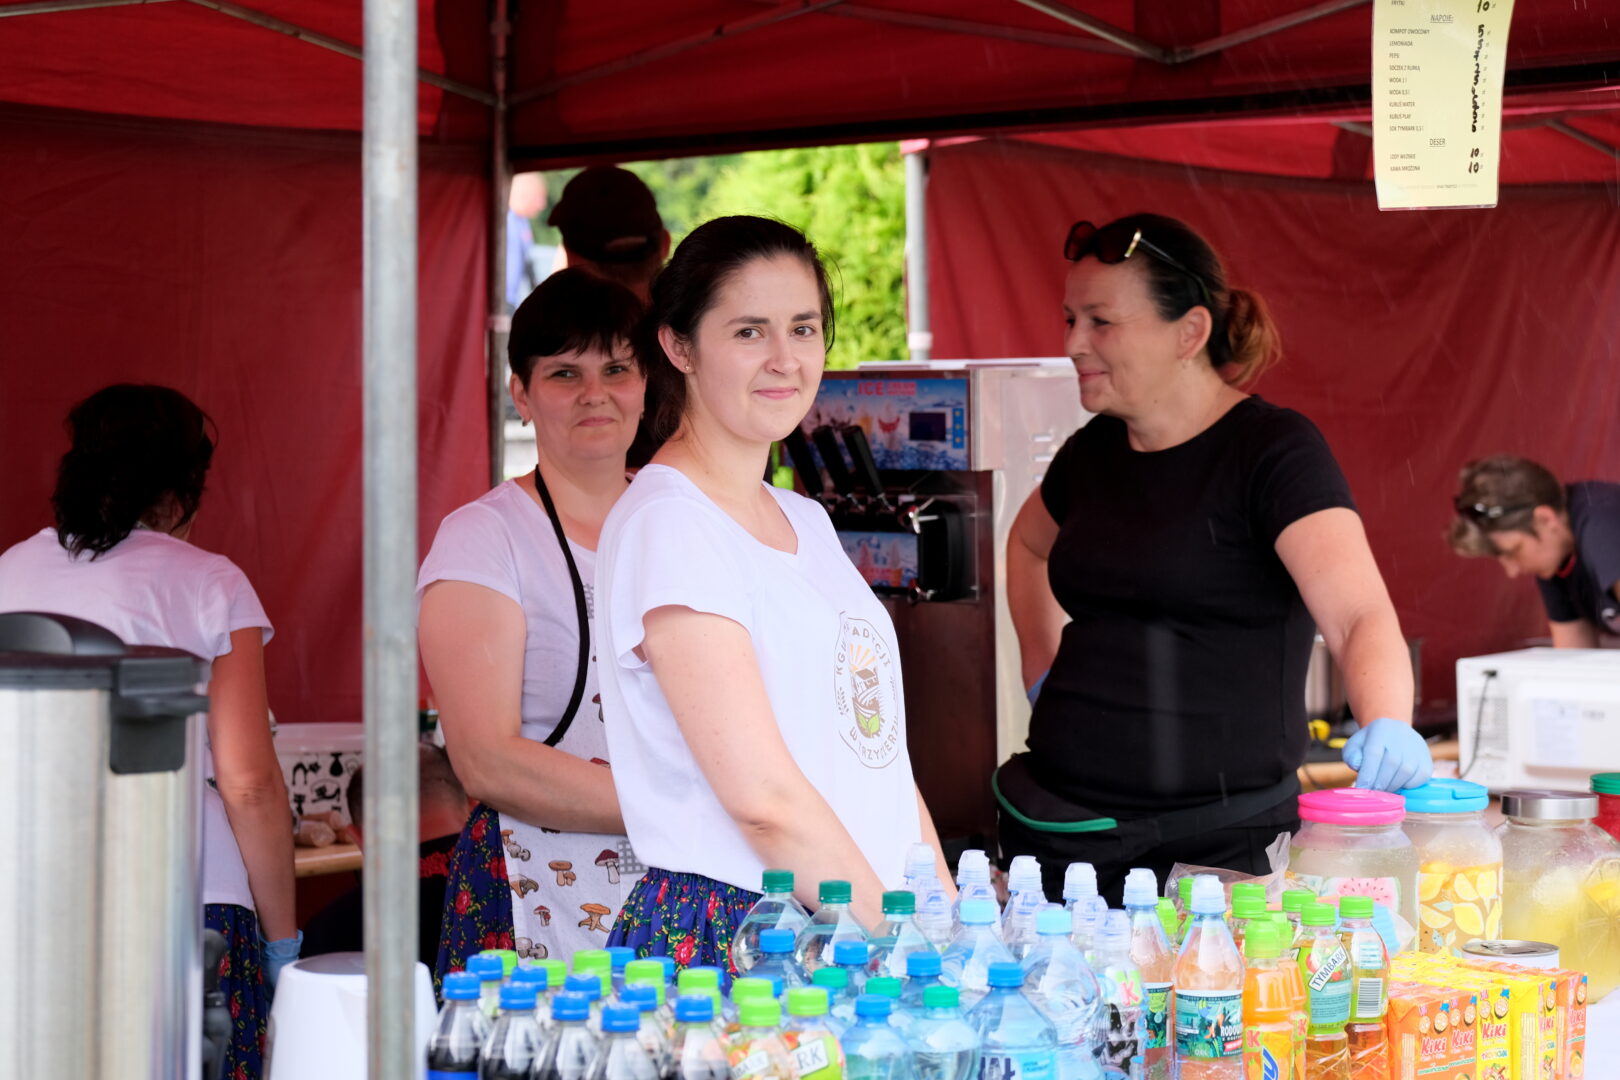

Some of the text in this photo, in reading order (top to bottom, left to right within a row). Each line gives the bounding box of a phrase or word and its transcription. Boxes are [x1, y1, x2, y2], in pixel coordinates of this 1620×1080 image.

[1477, 0, 1490, 13] 10
[1478, 24, 1485, 38] 5
[1429, 138, 1445, 146] DESER
[1470, 147, 1480, 158] 10
[1468, 160, 1480, 174] 10
[858, 381, 884, 396] ICE
[1311, 949, 1346, 988] TYMBARK
